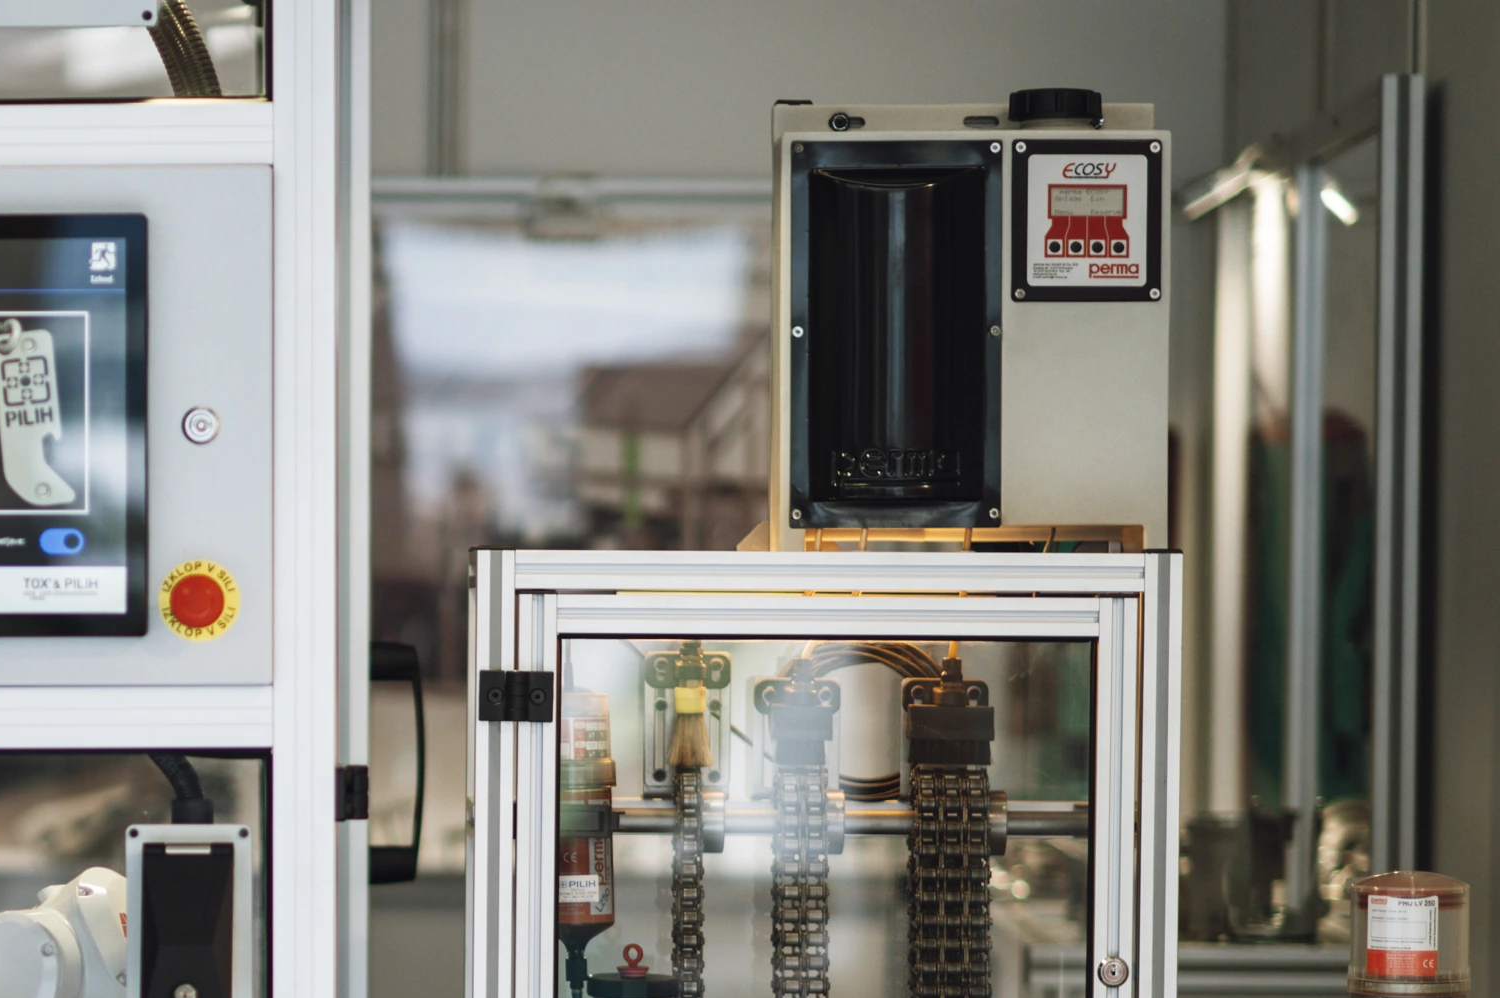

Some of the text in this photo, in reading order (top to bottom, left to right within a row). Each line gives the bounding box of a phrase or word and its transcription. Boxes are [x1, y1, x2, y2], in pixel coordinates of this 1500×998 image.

[1088, 263, 1139, 279] perma
[4, 406, 54, 428] PILIH
[64, 577, 98, 589] PILIH
[161, 561, 236, 593] IZKLOP V SILI
[161, 606, 236, 638] IZKLOP V SILI
[594, 838, 607, 886] perm
[569, 880, 596, 888] PILIH
[1424, 899, 1436, 907] 250
